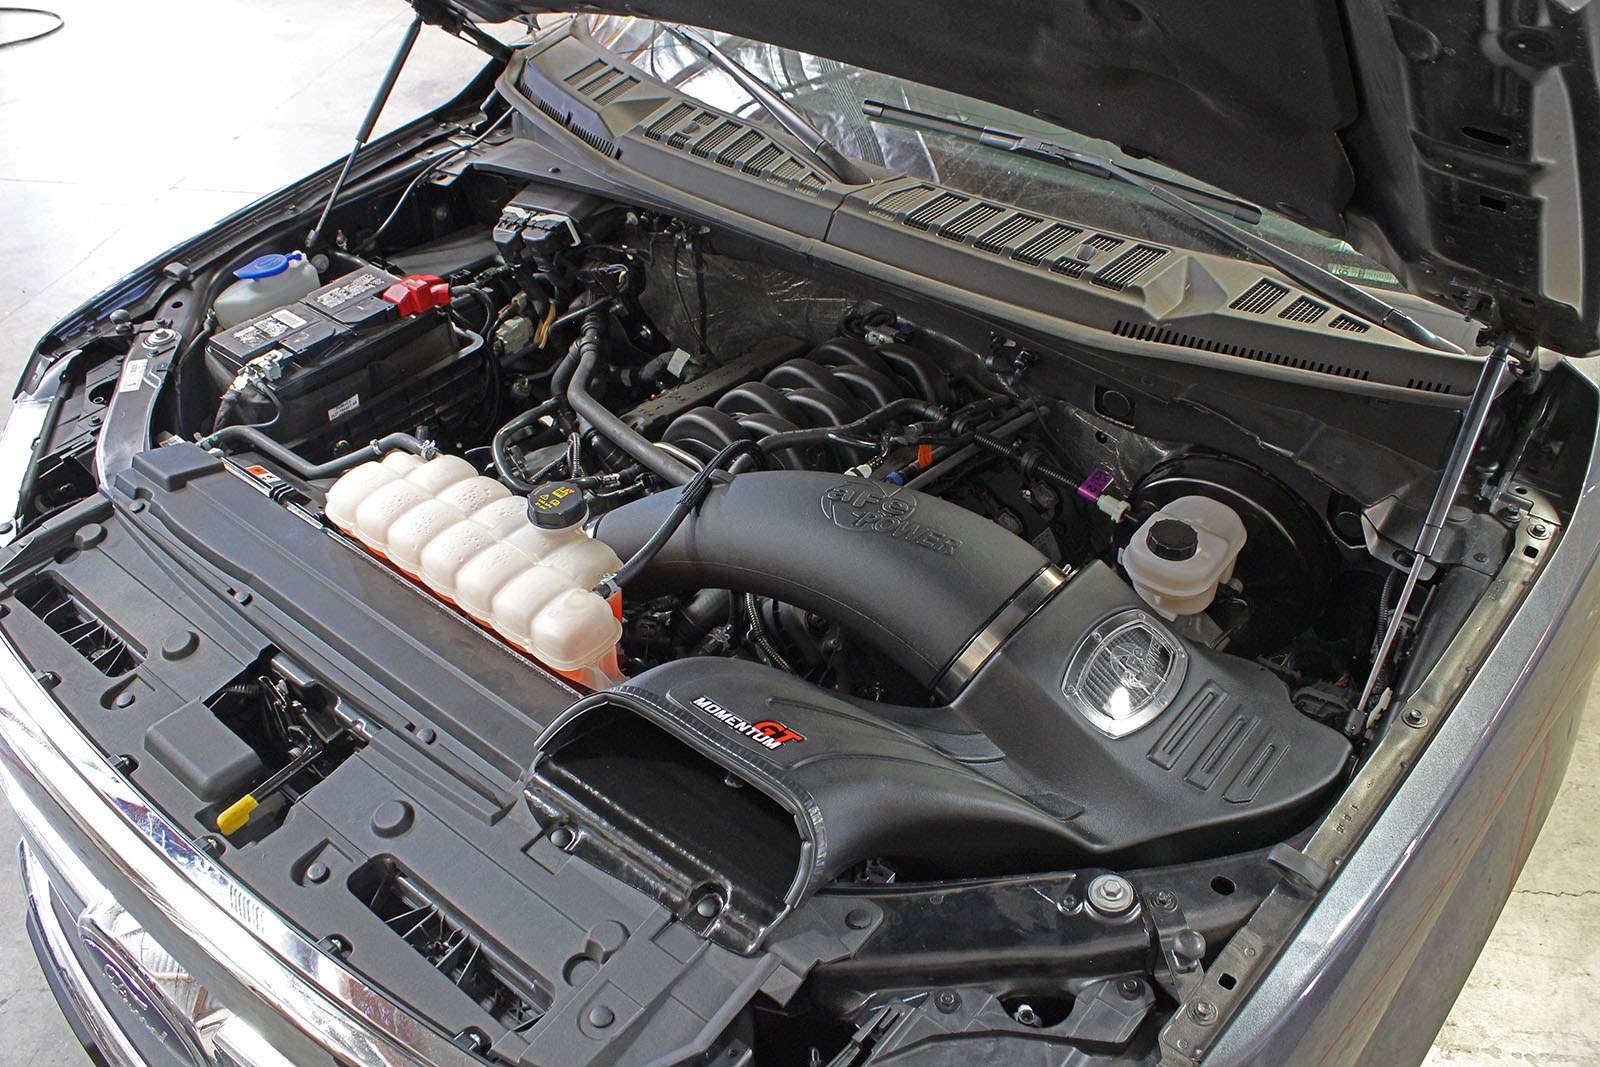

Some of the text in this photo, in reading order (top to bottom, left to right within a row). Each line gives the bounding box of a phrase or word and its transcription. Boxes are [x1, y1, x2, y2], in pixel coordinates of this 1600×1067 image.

[851, 510, 964, 557] POWER
[692, 696, 783, 751] MOMENTUM
[754, 720, 805, 744] GT
